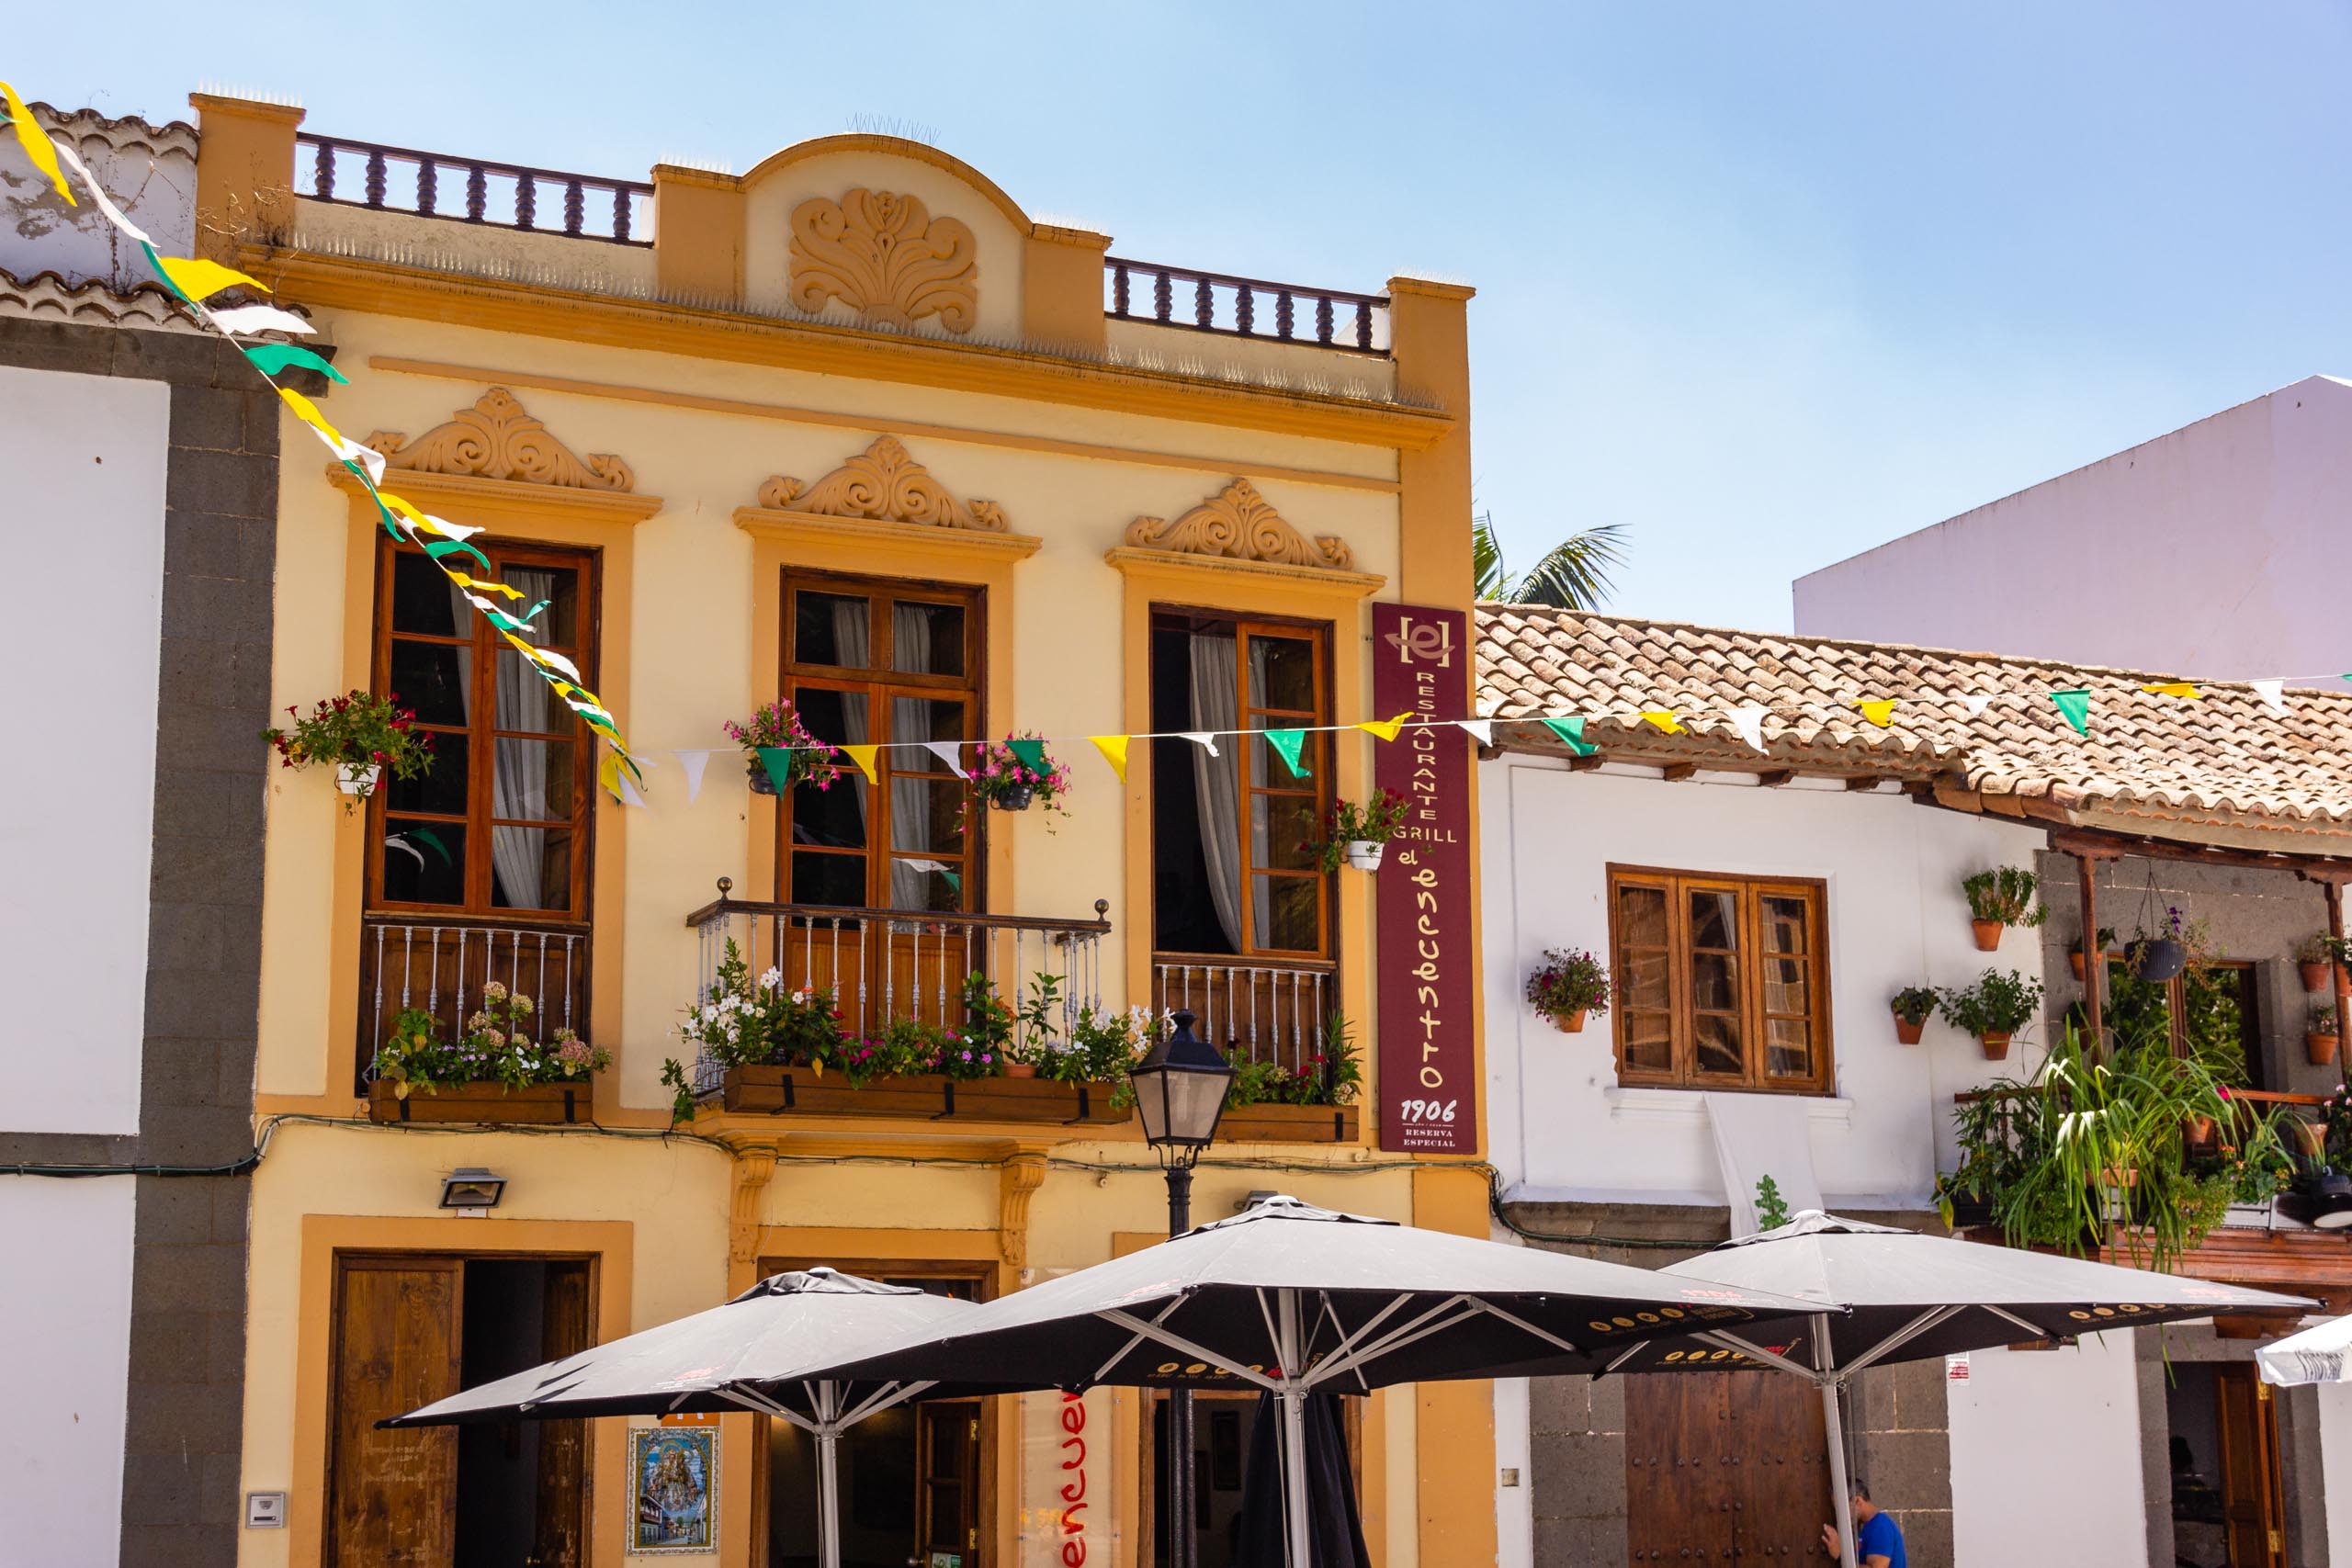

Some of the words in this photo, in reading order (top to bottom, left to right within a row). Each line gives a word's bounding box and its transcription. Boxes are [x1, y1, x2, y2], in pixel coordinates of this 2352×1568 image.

[1412, 671, 1438, 820] RESTAURANTE
[1392, 825, 1458, 843] GRILL
[1397, 849, 1419, 865] el
[1401, 1100, 1457, 1122] 1906
[1406, 1129, 1453, 1137] RESERVA
[1403, 1139, 1455, 1147] ESPECIAL
